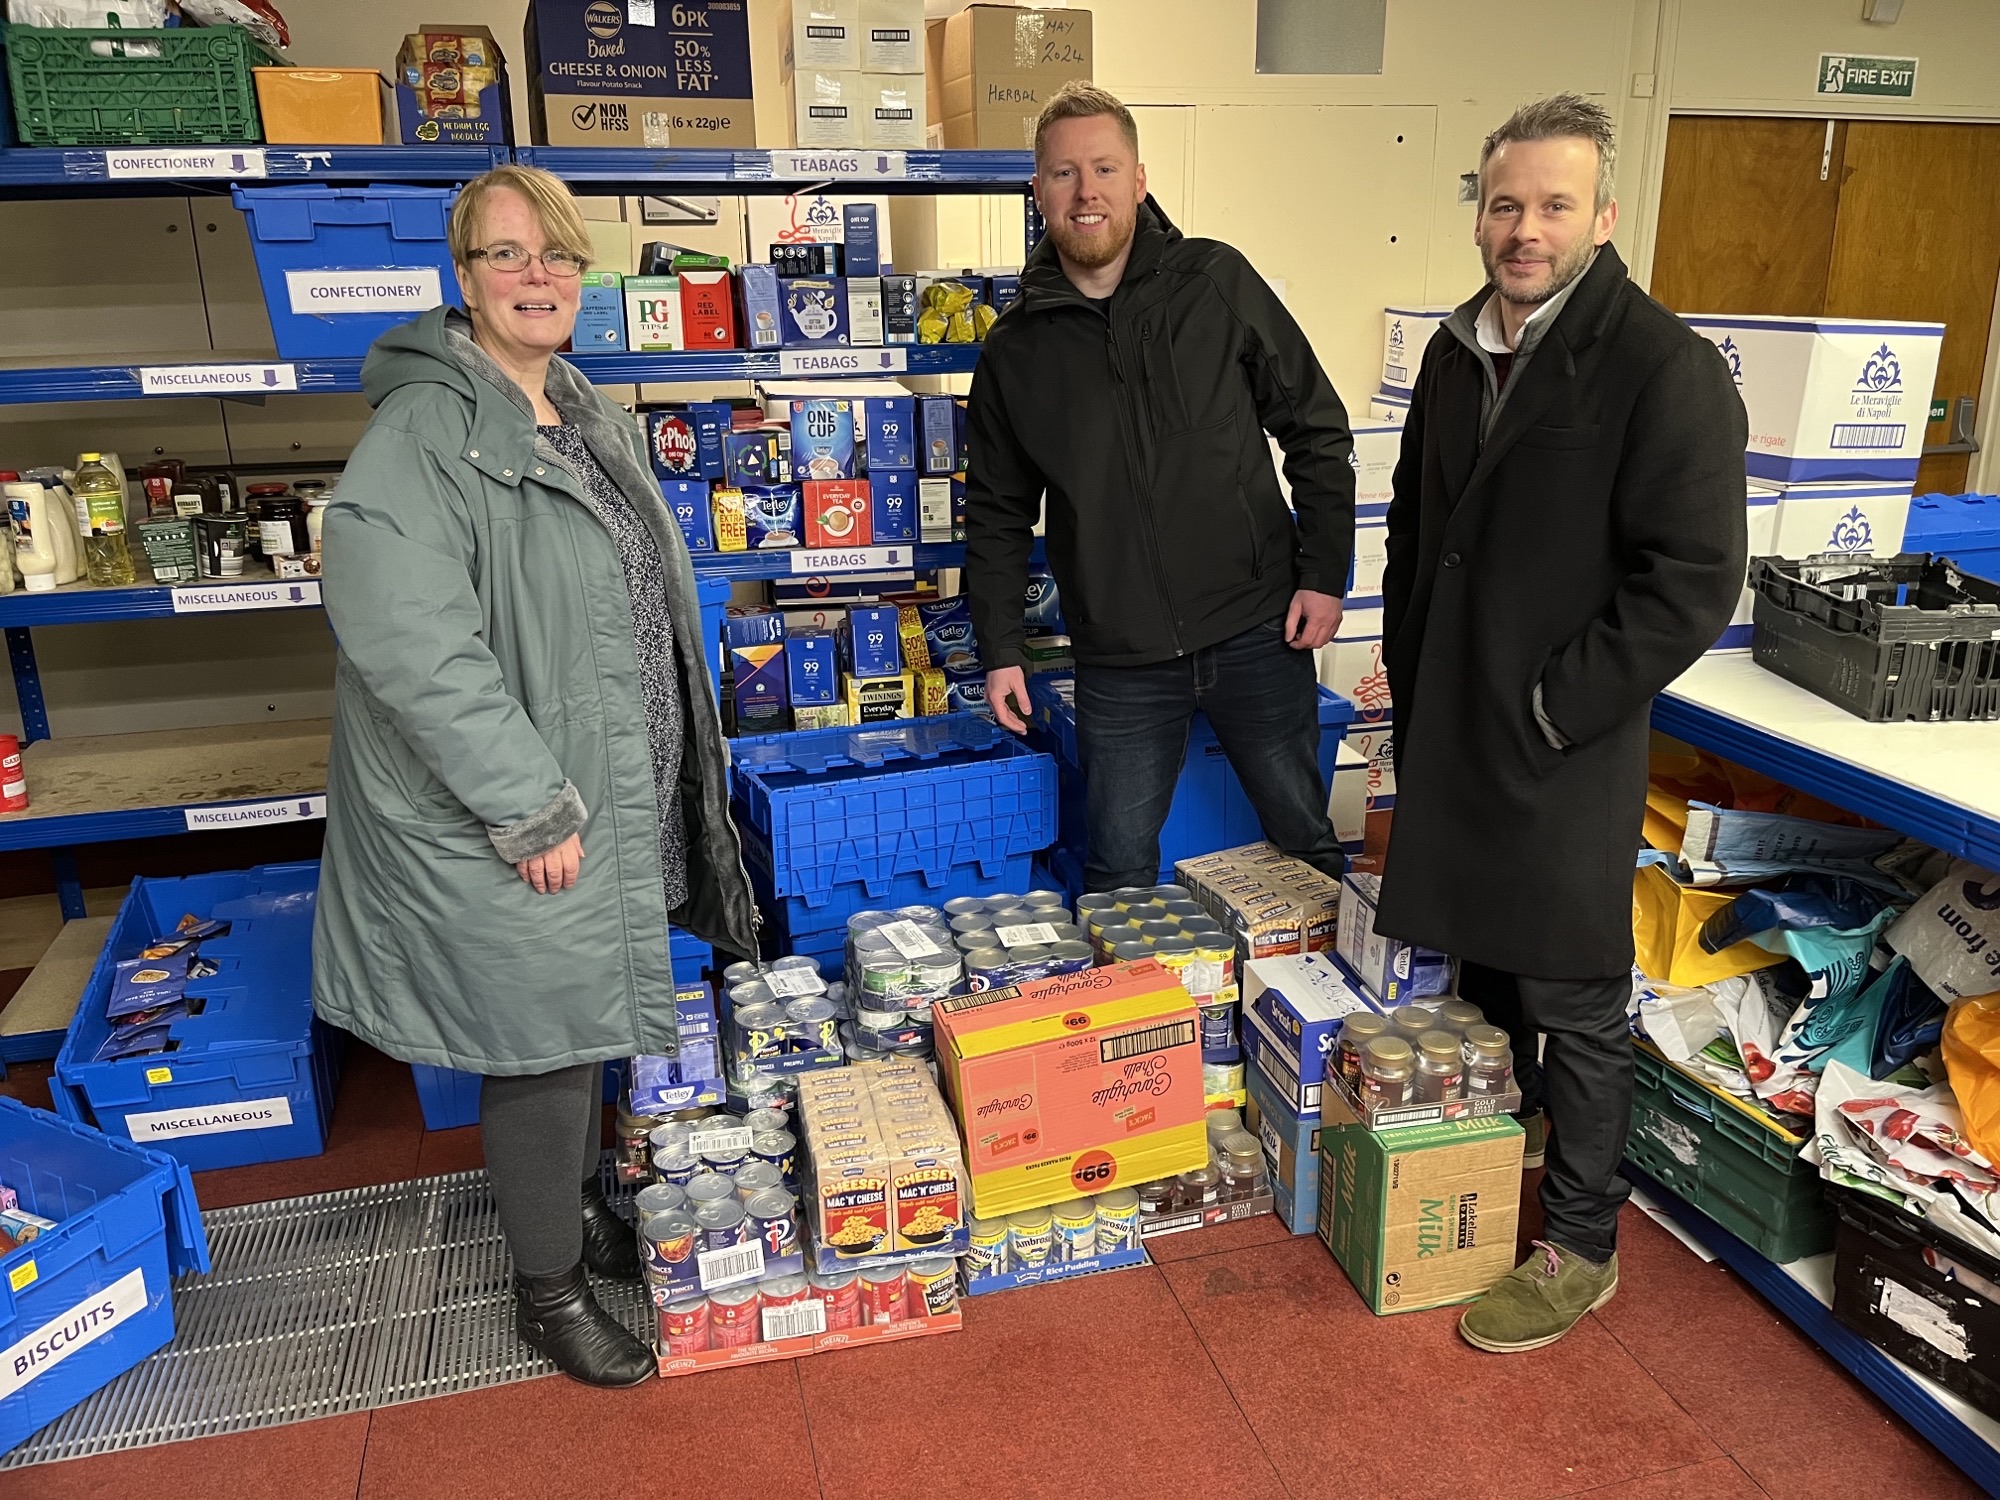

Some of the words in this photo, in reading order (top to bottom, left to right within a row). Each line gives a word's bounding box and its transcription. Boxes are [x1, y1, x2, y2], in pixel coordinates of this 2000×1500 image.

[586, 13, 621, 24] WALKERS
[671, 4, 710, 27] 6PK
[1047, 20, 1074, 34] MAY
[587, 38, 626, 58] Baked
[674, 40, 711, 57] 50%
[1041, 42, 1085, 64] 2024
[549, 62, 603, 76] CHEESE
[606, 64, 617, 76] &
[620, 65, 668, 78] ONION
[675, 59, 712, 71] LESS
[1846, 68, 1878, 84] FIRE
[1880, 70, 1912, 86] EXIT
[577, 80, 600, 88] Flavour
[624, 81, 643, 89] Snack
[988, 84, 1038, 104] HERBAL
[600, 103, 627, 117] NON
[600, 118, 629, 131] HFSS
[112, 157, 215, 169] CONFECTIONERY
[790, 158, 859, 172] TEABAGS
[310, 285, 422, 299] CONFECTIONERY
[638, 299, 670, 324] PG
[692, 308, 720, 316] LABEL
[697, 301, 714, 309] RED
[640, 323, 662, 331] TIPS
[792, 356, 859, 370] TEABAGS
[150, 372, 252, 386] MISCELLANEOUS
[1850, 395, 1861, 405] Le
[1862, 395, 1903, 410] Meraviglie
[806, 410, 837, 423] ONE
[1857, 408, 1866, 418] di
[1867, 407, 1894, 420] Napoli
[1930, 407, 1944, 417] en
[808, 424, 837, 438] CUP
[883, 423, 898, 436] 99
[1761, 434, 1787, 447] rigate
[822, 492, 852, 500] EVERYDAY
[886, 497, 902, 510] 99
[676, 505, 694, 518] 99
[719, 511, 744, 522] EXTRA
[720, 520, 746, 538] FREE
[804, 553, 867, 567] TEABAGS
[178, 590, 278, 605] MISCELLANEOUS
[868, 634, 884, 645] 99
[939, 626, 967, 640] Tetley
[905, 636, 925, 650] 50%
[908, 651, 927, 661] EXTRA
[803, 662, 820, 673] 99
[909, 658, 930, 670] FREE
[862, 691, 902, 701] TWININGS
[927, 686, 945, 702] 50%
[962, 685, 986, 697] Tetle
[863, 704, 895, 717] Everyday
[193, 805, 288, 822] MISCELLANEOUS
[1250, 919, 1303, 937] CHEESEY
[1937, 903, 1988, 954] from
[1255, 935, 1269, 946] MAC
[1279, 931, 1301, 943] CHEESE
[1398, 950, 1409, 976] Tetley
[1057, 966, 1102, 982] Shells
[1030, 974, 1112, 1001] Conchiglie
[1066, 1038, 1083, 1049] 500g
[783, 1060, 805, 1070] PINEAPPLE
[1122, 1055, 1168, 1080] Shells
[664, 1088, 691, 1102] Tetley
[1091, 1072, 1172, 1108] Conchiglie
[1475, 1099, 1496, 1107] GOLD
[150, 1109, 273, 1132] MISCELLANEOUS
[1128, 1111, 1154, 1127] JACK'S
[1454, 1116, 1504, 1131] Milk
[1382, 1125, 1452, 1139] SEMI-SKIMMED
[992, 1136, 1017, 1151] JACK'S
[1263, 1126, 1278, 1153] Milk
[1025, 1163, 1040, 1171] PACKS
[1041, 1159, 1059, 1168] MARKED
[894, 1168, 957, 1188] CHEESEY
[1075, 1162, 1111, 1183] 99p
[1340, 1140, 1357, 1214] Milk
[821, 1179, 887, 1198] CHEESEY
[899, 1186, 918, 1199] MAC
[929, 1181, 955, 1196] CHEESE
[826, 1196, 845, 1208] MAC
[858, 1190, 884, 1204] CHEESE
[1232, 1202, 1251, 1211] GOLD
[1099, 1218, 1128, 1232] brosia
[1418, 1199, 1444, 1259] Milk
[1446, 1194, 1456, 1253] SEMI-SKIMMED
[1459, 1206, 1467, 1247] DAIRIES
[1466, 1202, 1476, 1249] Lakeland
[1015, 1233, 1050, 1250] Ambros
[969, 1247, 992, 1261] rosia
[1028, 1259, 1046, 1269] Rice
[1046, 1268, 1063, 1276] Rice
[1065, 1259, 1100, 1273] Pudding
[671, 1284, 698, 1295] PRINCES
[931, 1277, 952, 1291] HEINZ
[14, 1299, 116, 1377] BISCUITS
[823, 1335, 847, 1346] HEINZ
[669, 1359, 694, 1372] HEINZ
